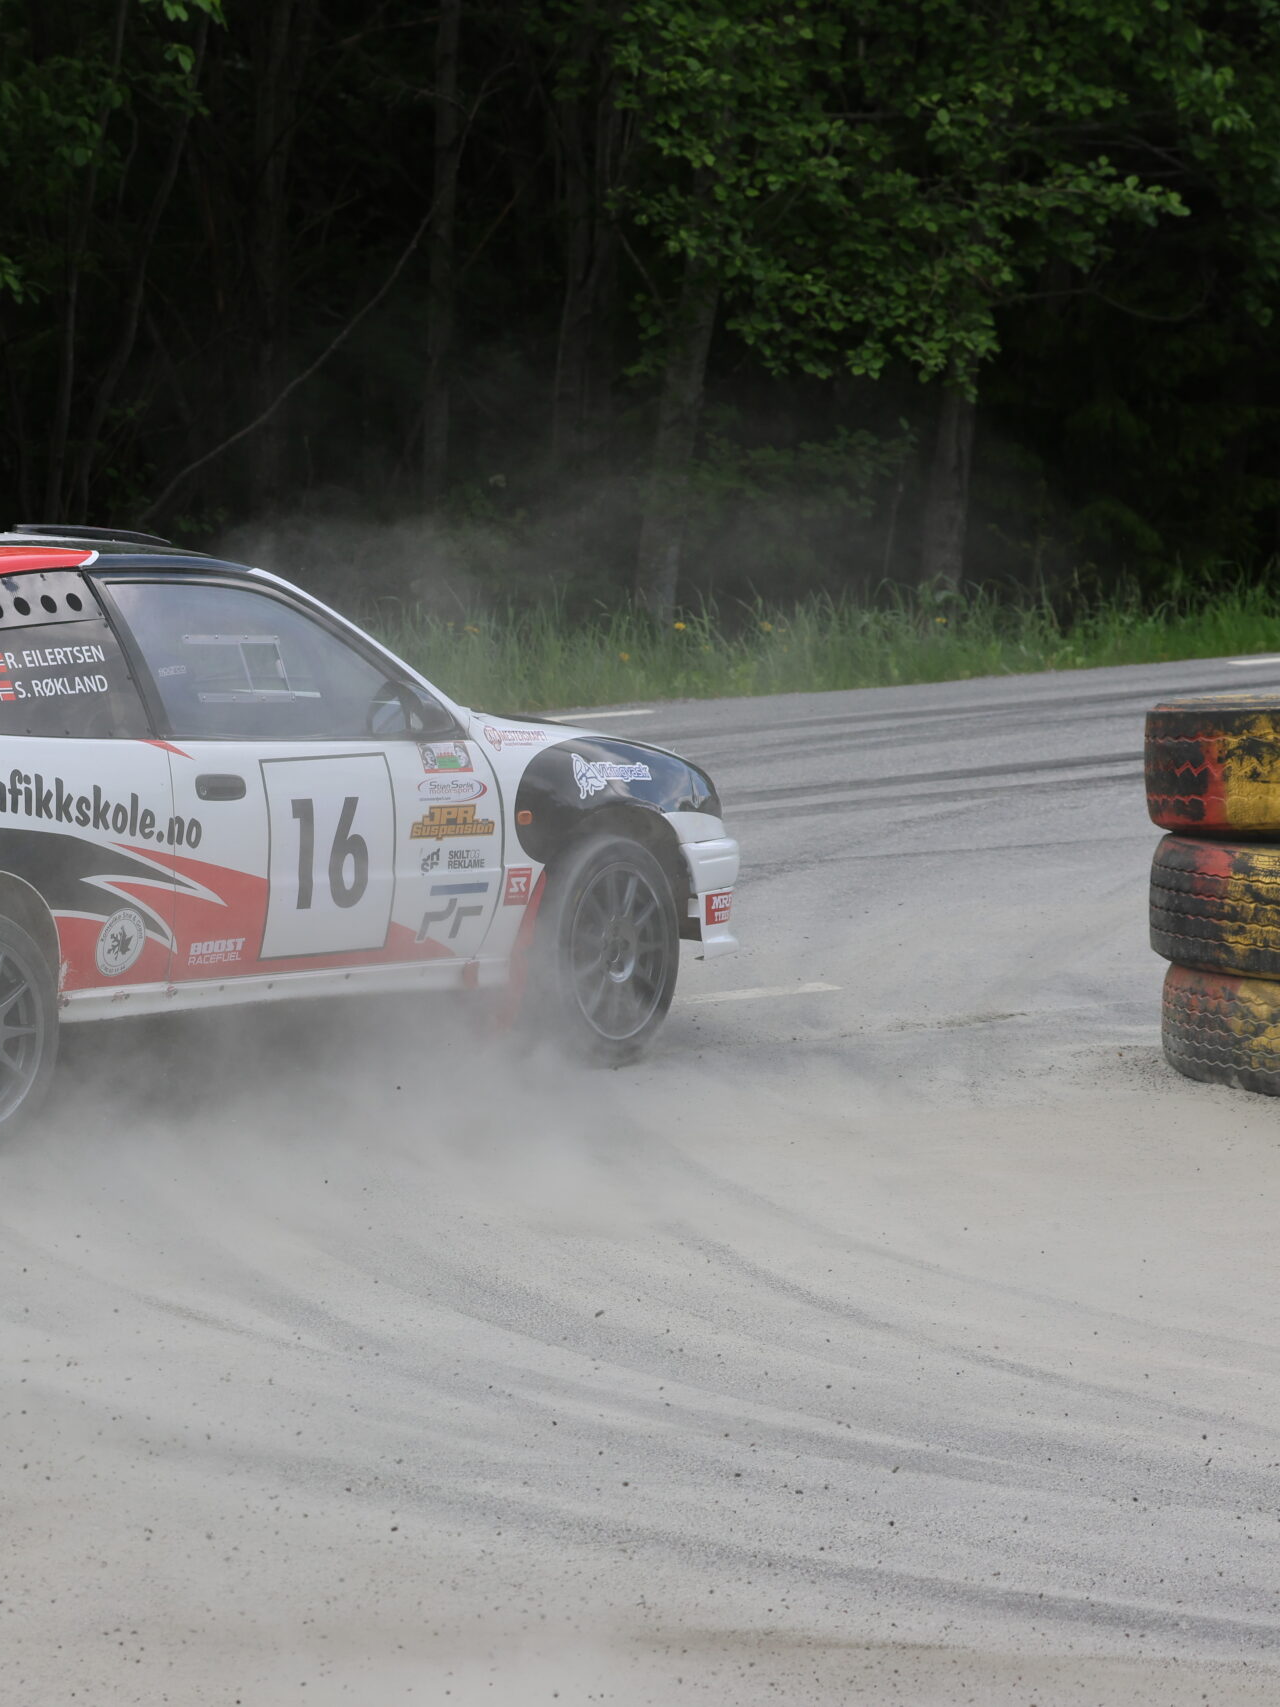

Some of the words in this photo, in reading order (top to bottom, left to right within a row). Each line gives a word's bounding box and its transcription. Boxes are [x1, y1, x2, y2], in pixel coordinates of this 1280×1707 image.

[5, 652, 23, 670] R.
[23, 645, 106, 668] EILERTSEN
[14, 681, 32, 699] S.
[32, 674, 109, 698] RØKLAND
[423, 805, 476, 826] JPR
[291, 797, 369, 910] 16
[448, 859, 485, 870] REKLAME
[189, 937, 246, 956] BOOST
[187, 951, 242, 966] RACEFUEL
